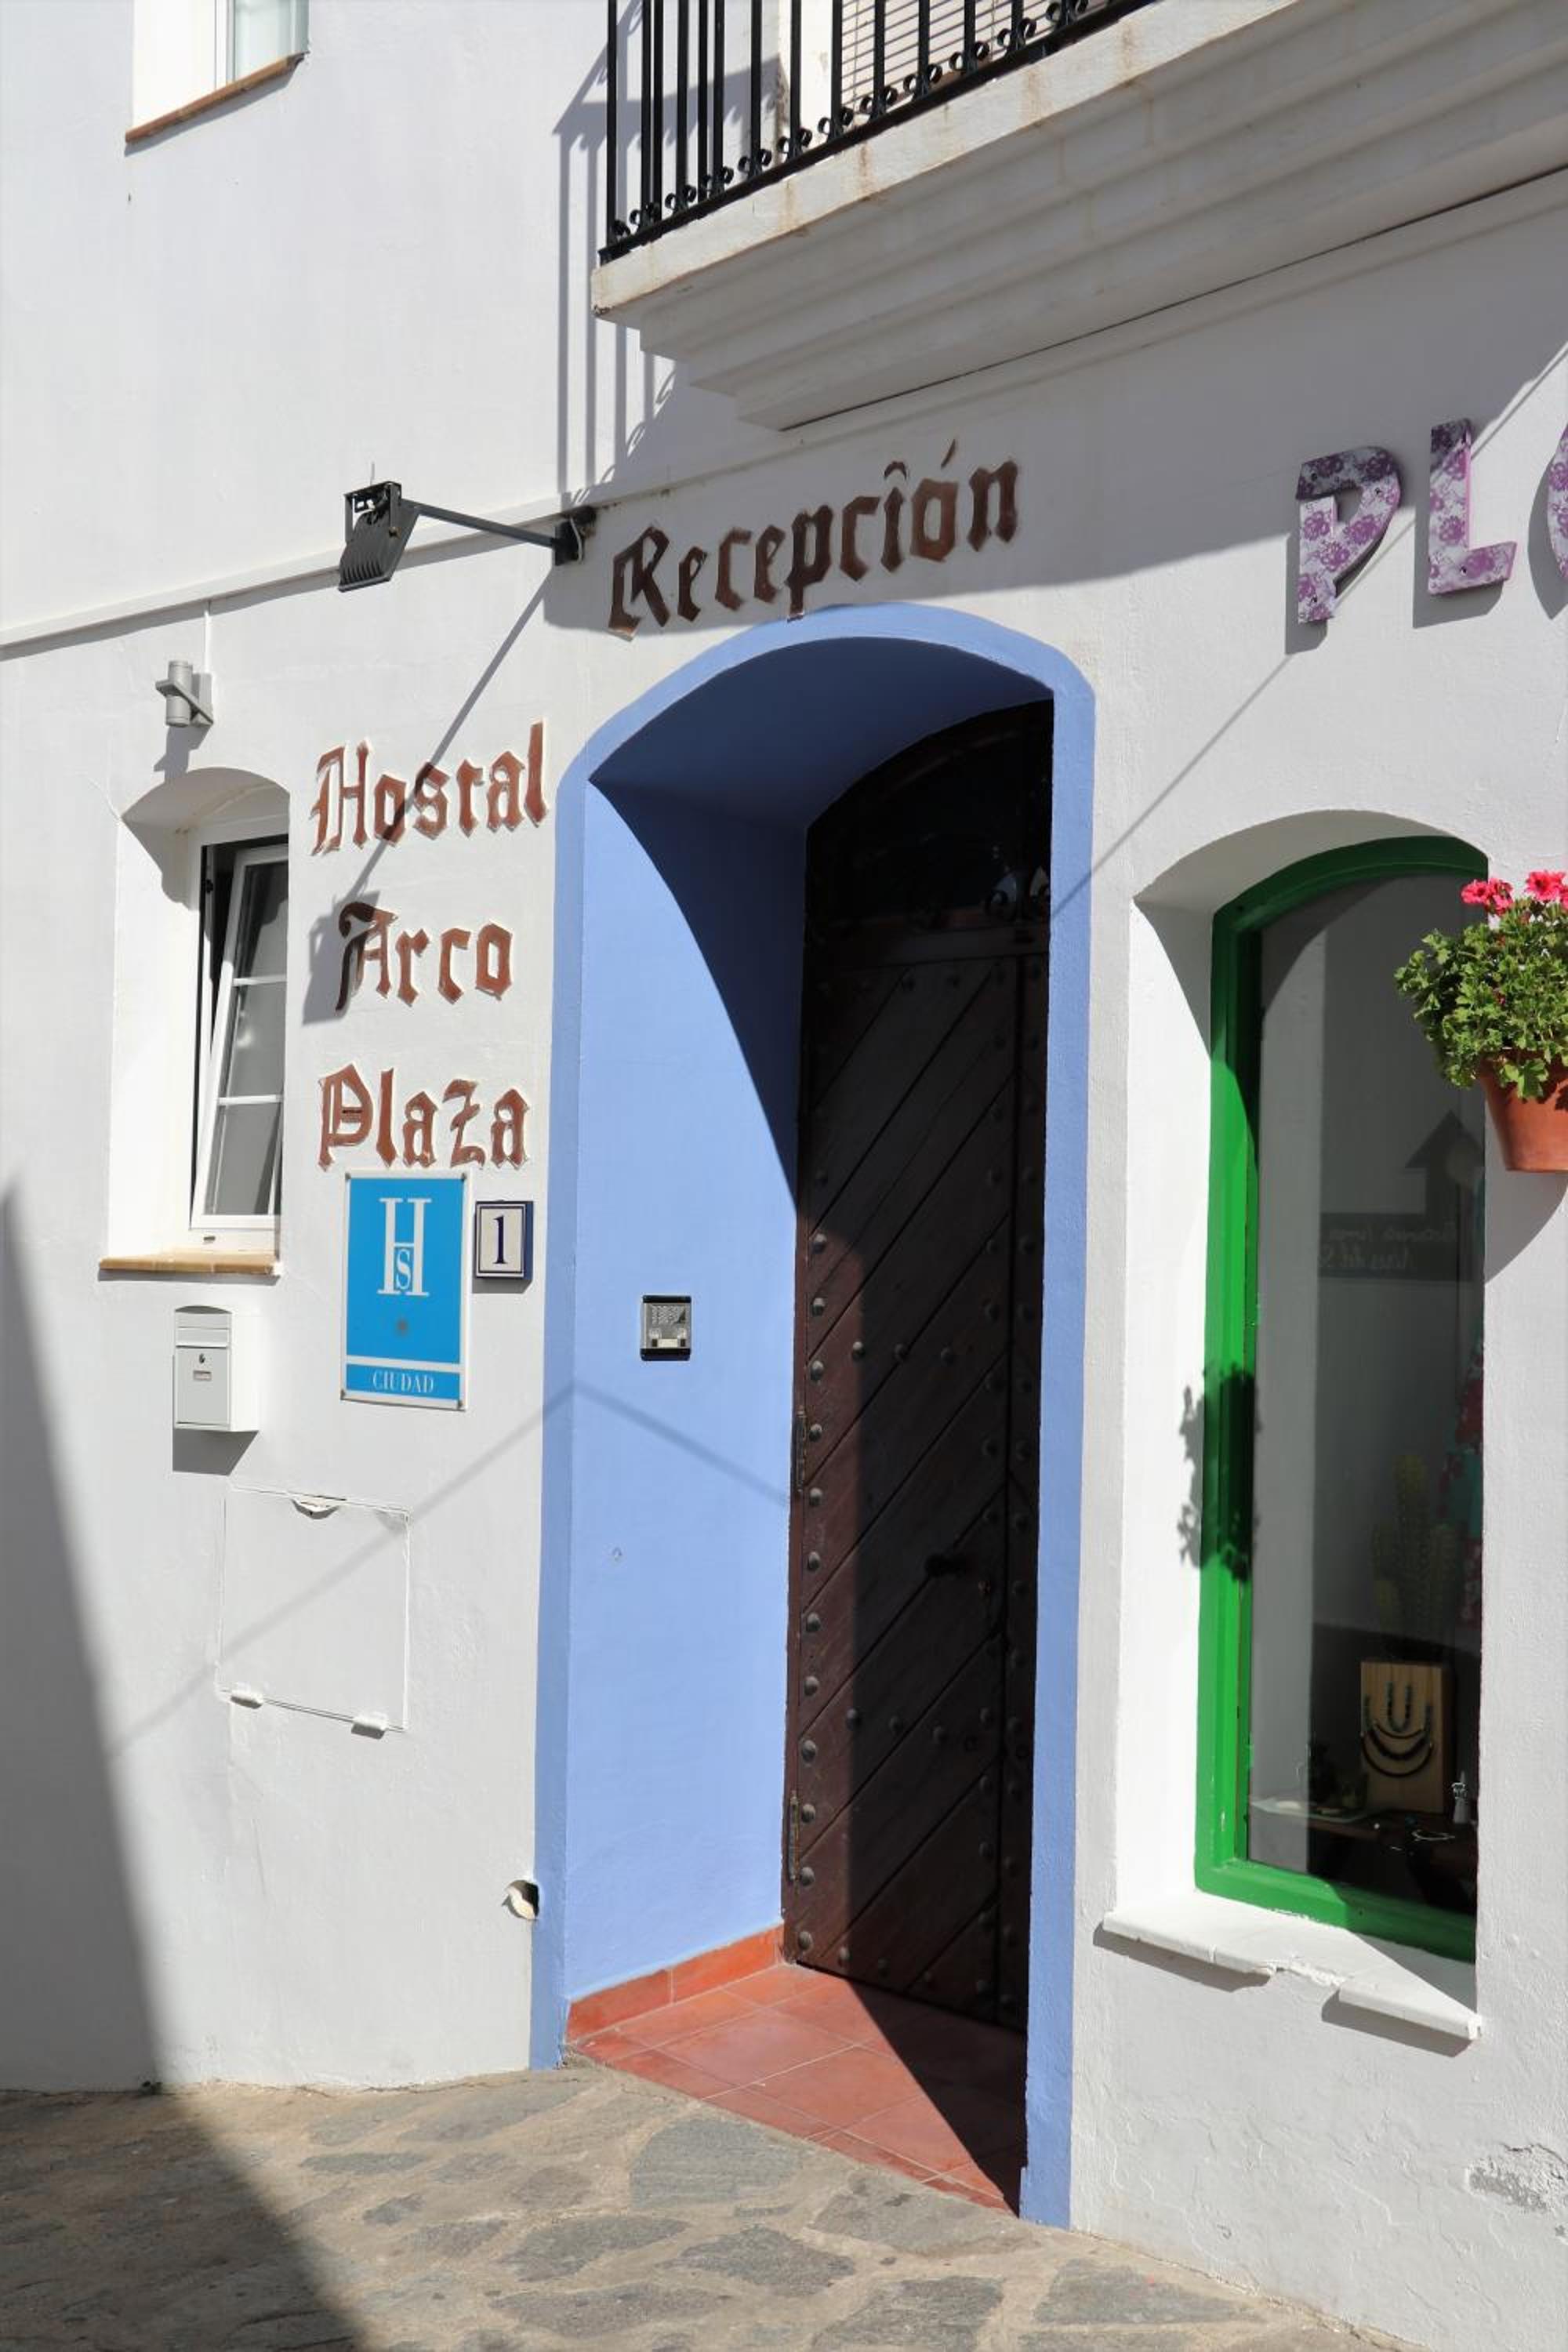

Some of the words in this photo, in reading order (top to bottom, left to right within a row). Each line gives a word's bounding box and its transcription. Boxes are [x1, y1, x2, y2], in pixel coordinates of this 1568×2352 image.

[1295, 417, 1568, 625] PL
[309, 719, 550, 855] Hostal
[336, 901, 514, 1013] Arco
[318, 1063, 530, 1172] Plaza
[492, 1215, 508, 1265] 1
[372, 1370, 434, 1395] CIUDAD
